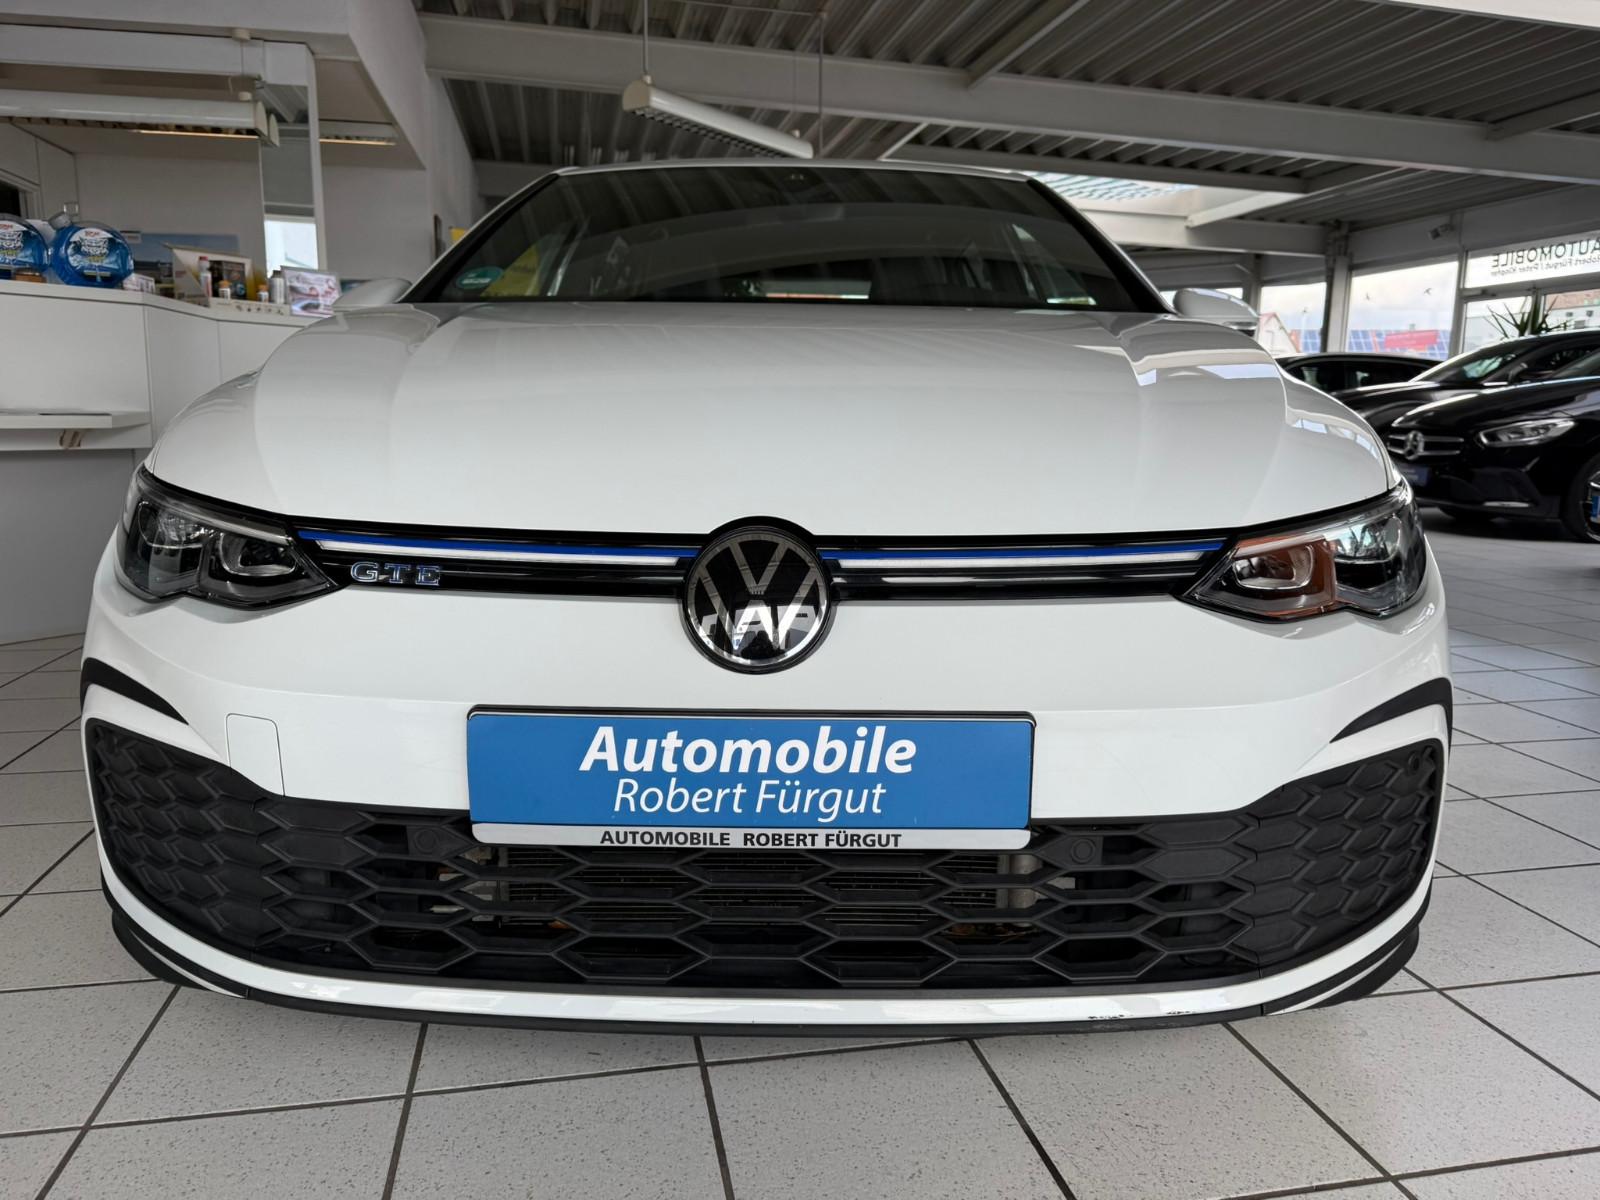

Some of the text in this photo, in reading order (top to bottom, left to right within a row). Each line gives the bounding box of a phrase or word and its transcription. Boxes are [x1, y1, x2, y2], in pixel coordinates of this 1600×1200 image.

[350, 561, 440, 586] GTE
[579, 725, 917, 774] Automobile
[613, 778, 886, 823] Robert Fürgut
[600, 829, 903, 849] AUTOMOBILE ROBERT FÜRGUT
